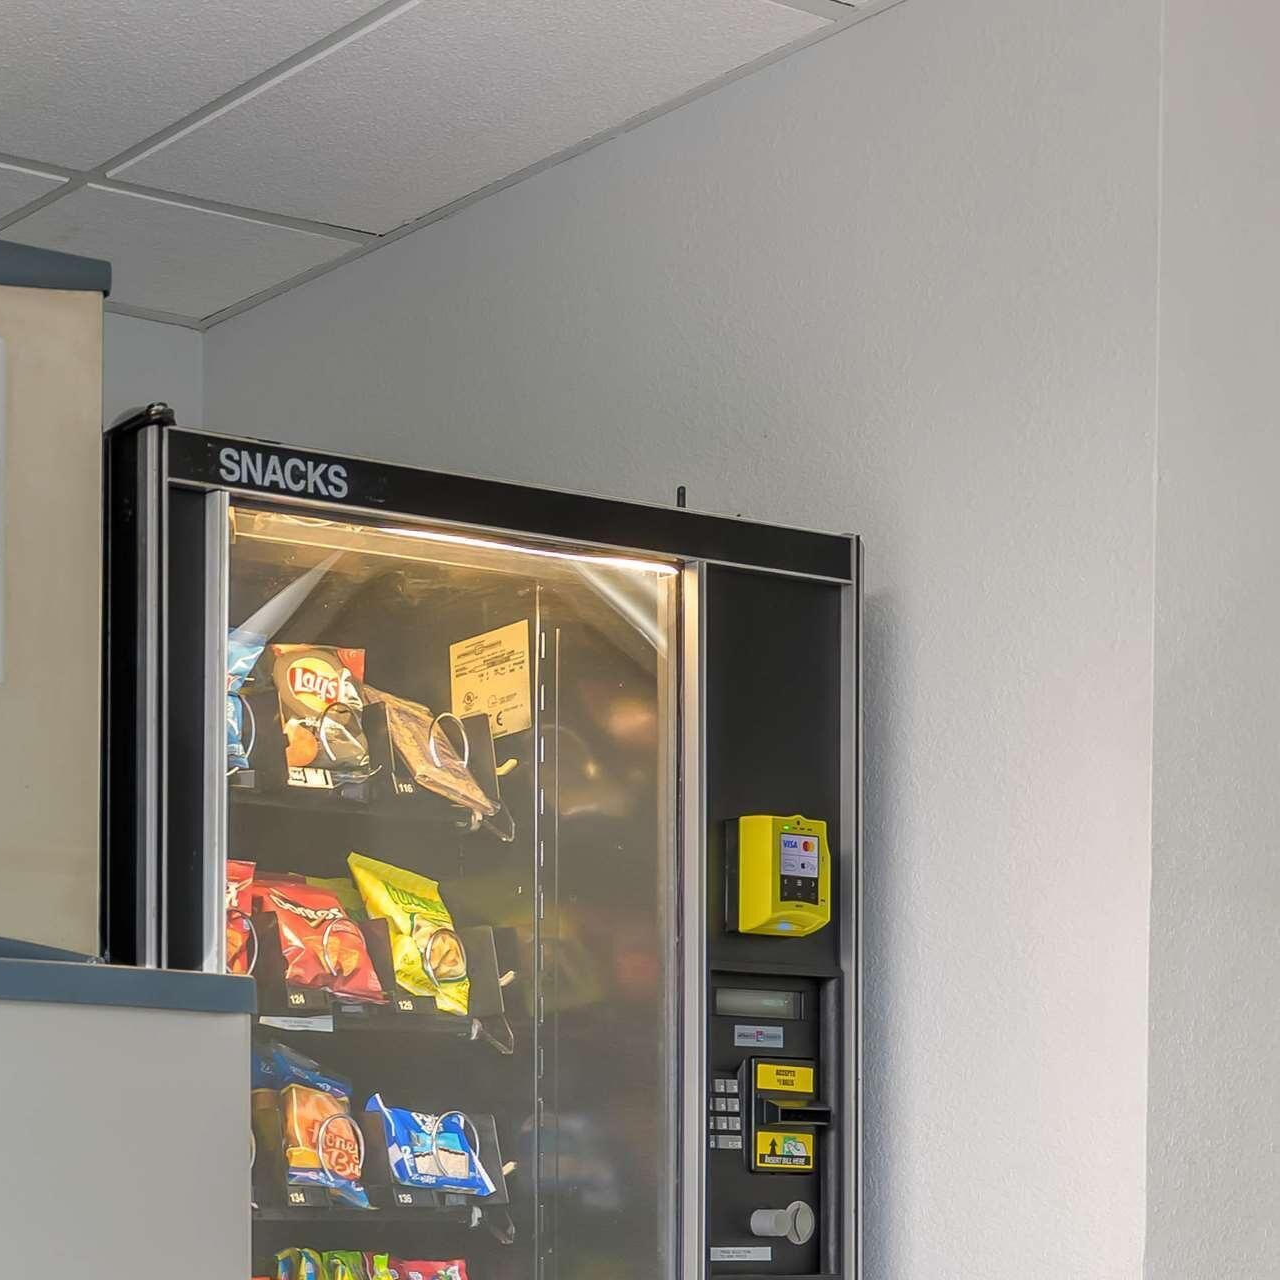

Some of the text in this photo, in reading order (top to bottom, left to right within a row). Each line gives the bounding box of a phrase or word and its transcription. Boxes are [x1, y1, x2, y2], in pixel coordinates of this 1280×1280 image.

[218, 446, 349, 499] SNACKS
[398, 784, 413, 794] 116
[783, 840, 798, 849] VISA
[290, 993, 305, 1004] 124
[290, 1193, 305, 1203] 134
